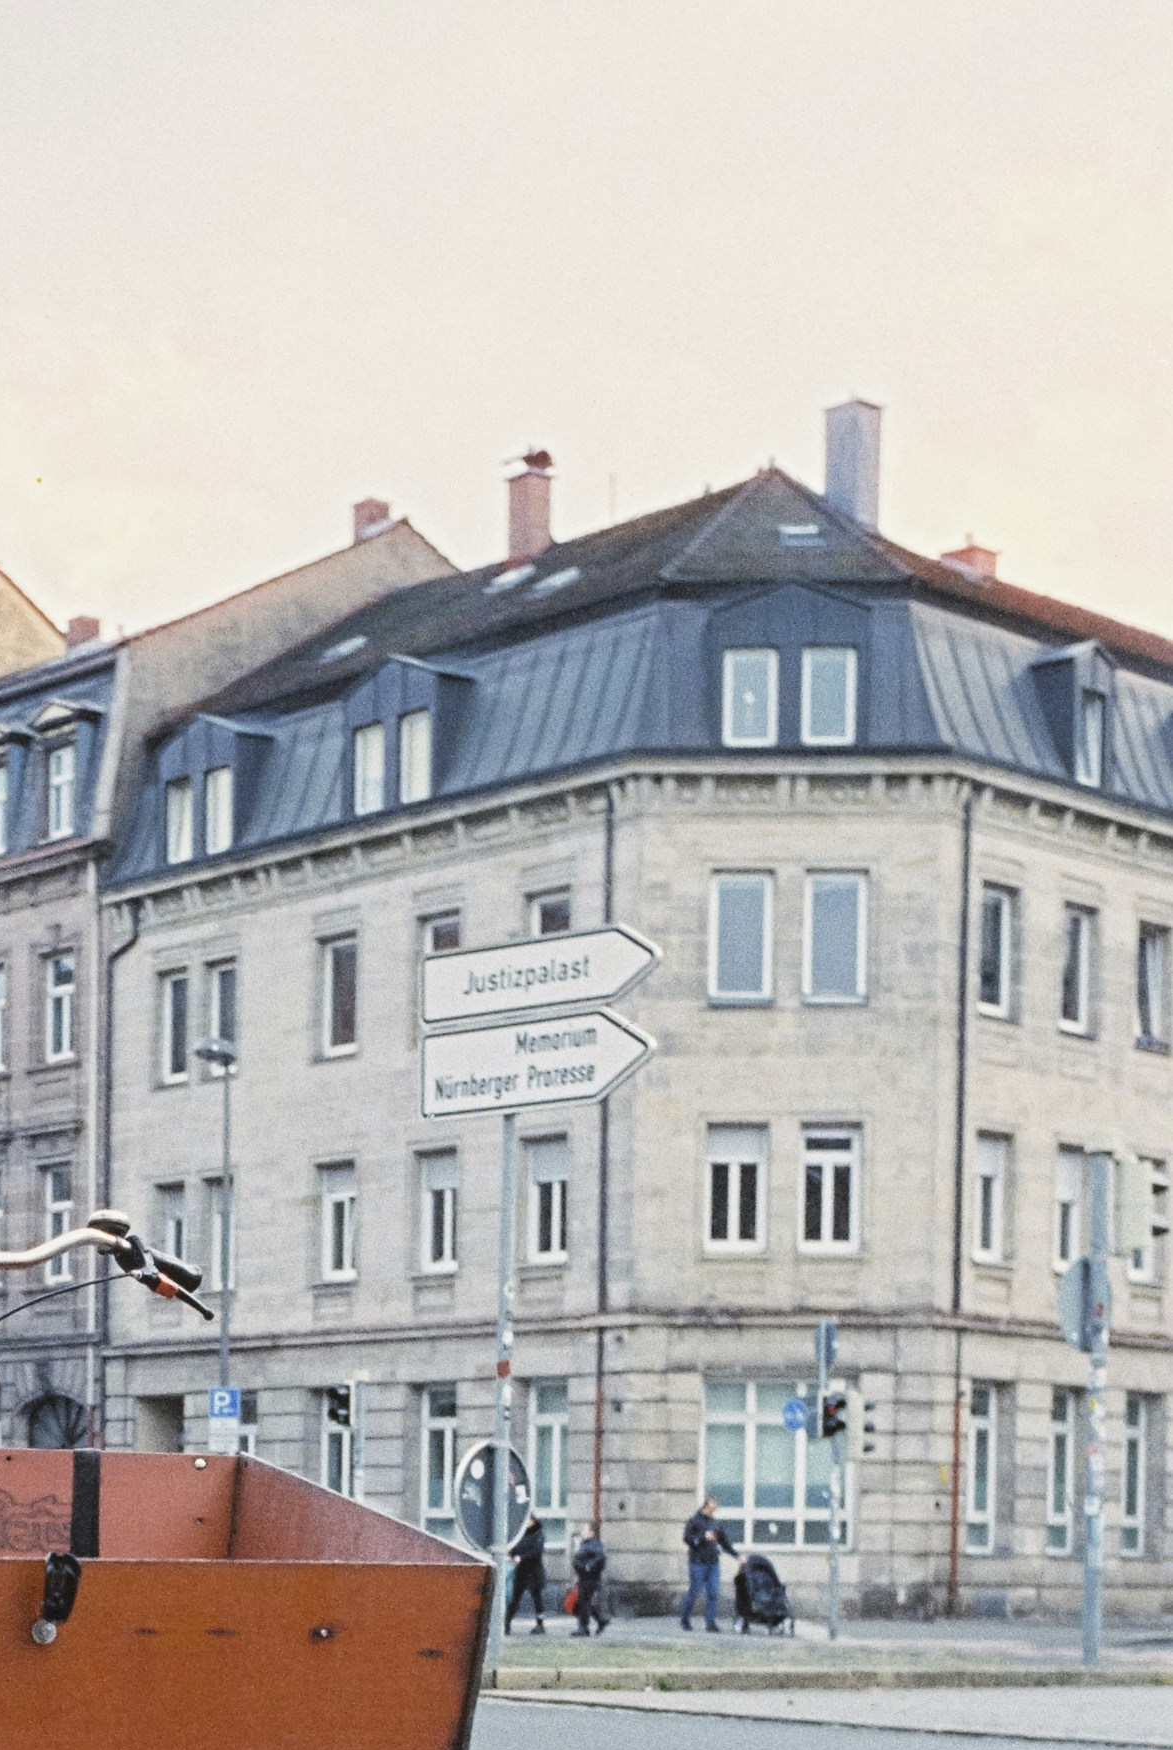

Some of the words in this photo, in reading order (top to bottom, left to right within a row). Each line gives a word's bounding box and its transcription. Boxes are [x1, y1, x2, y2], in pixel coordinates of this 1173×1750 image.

[463, 955, 590, 995] Justizpalast
[515, 1027, 597, 1054] Memorium
[435, 1072, 519, 1100] Nürnberger
[527, 1063, 596, 1089] Prozesse
[213, 1391, 230, 1415] P
